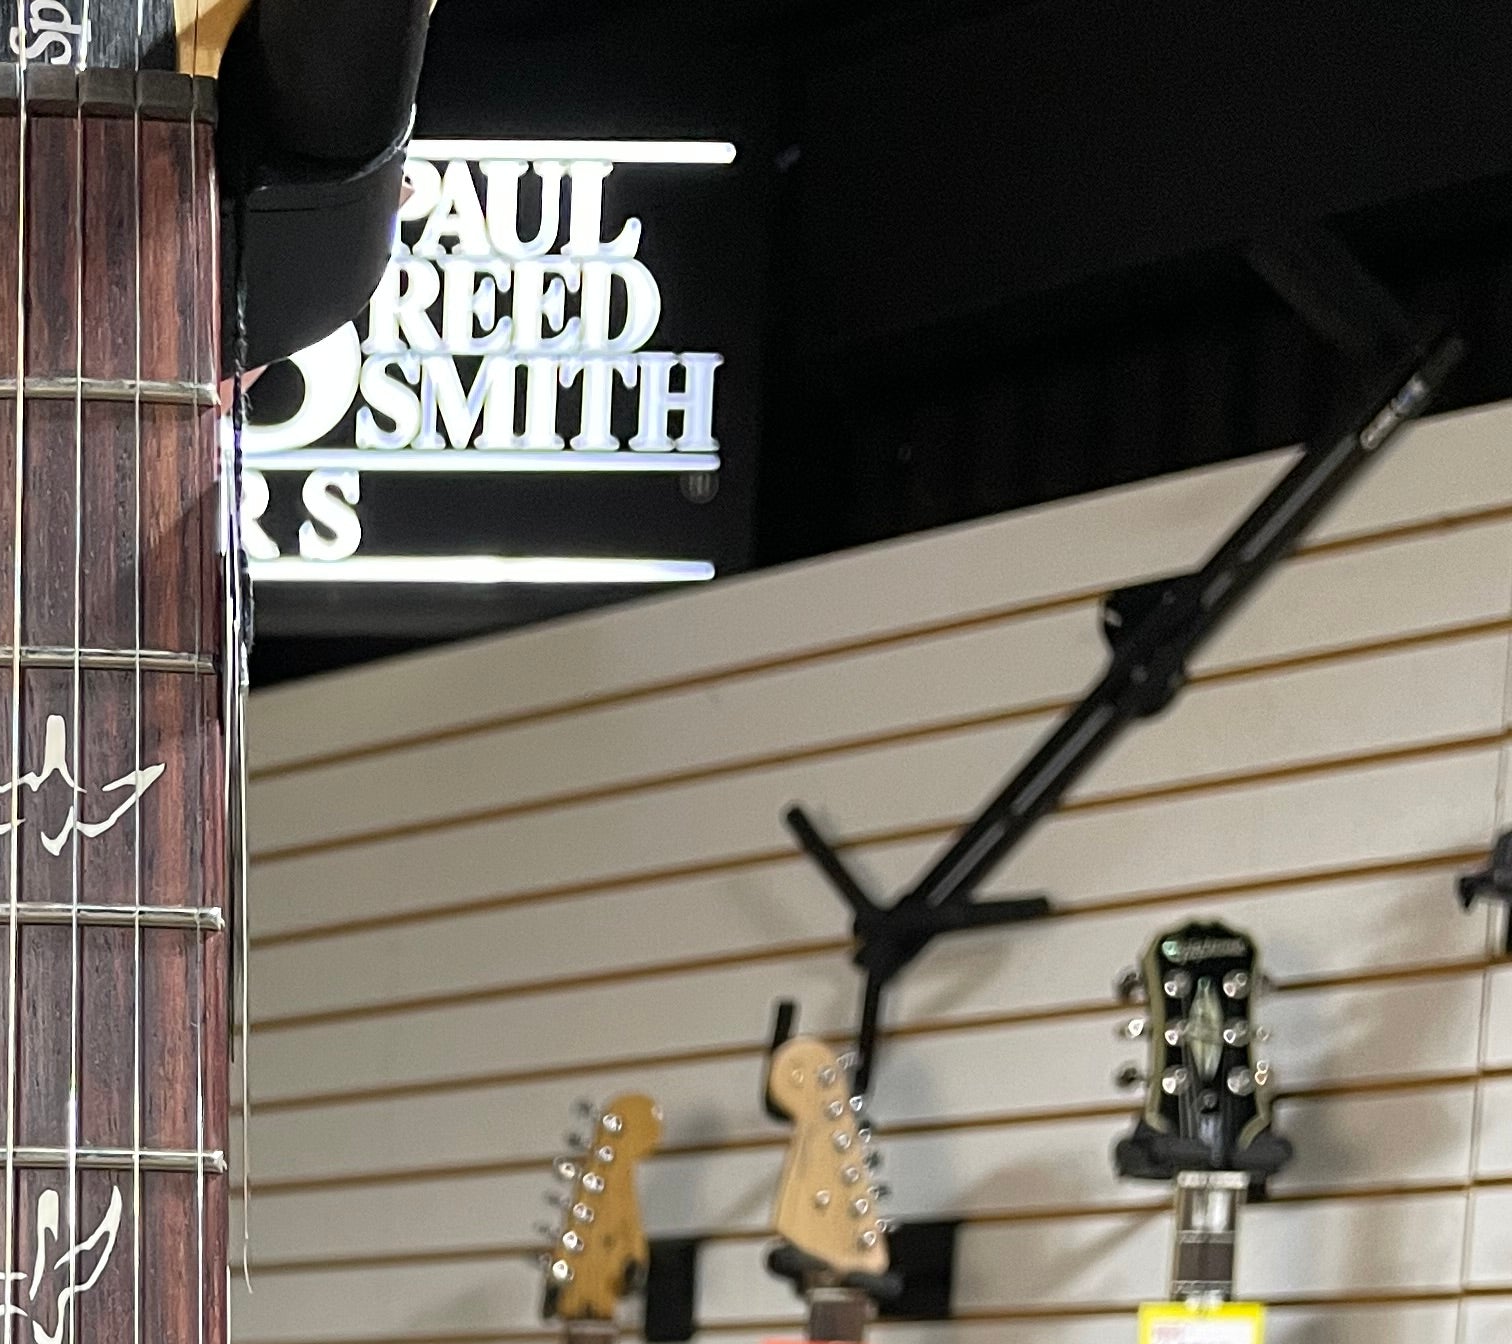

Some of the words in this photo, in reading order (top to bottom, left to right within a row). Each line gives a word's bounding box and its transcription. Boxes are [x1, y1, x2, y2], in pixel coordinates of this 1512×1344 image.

[393, 158, 642, 259] PAUL
[361, 257, 662, 355] REED
[355, 351, 725, 452] SMITH
